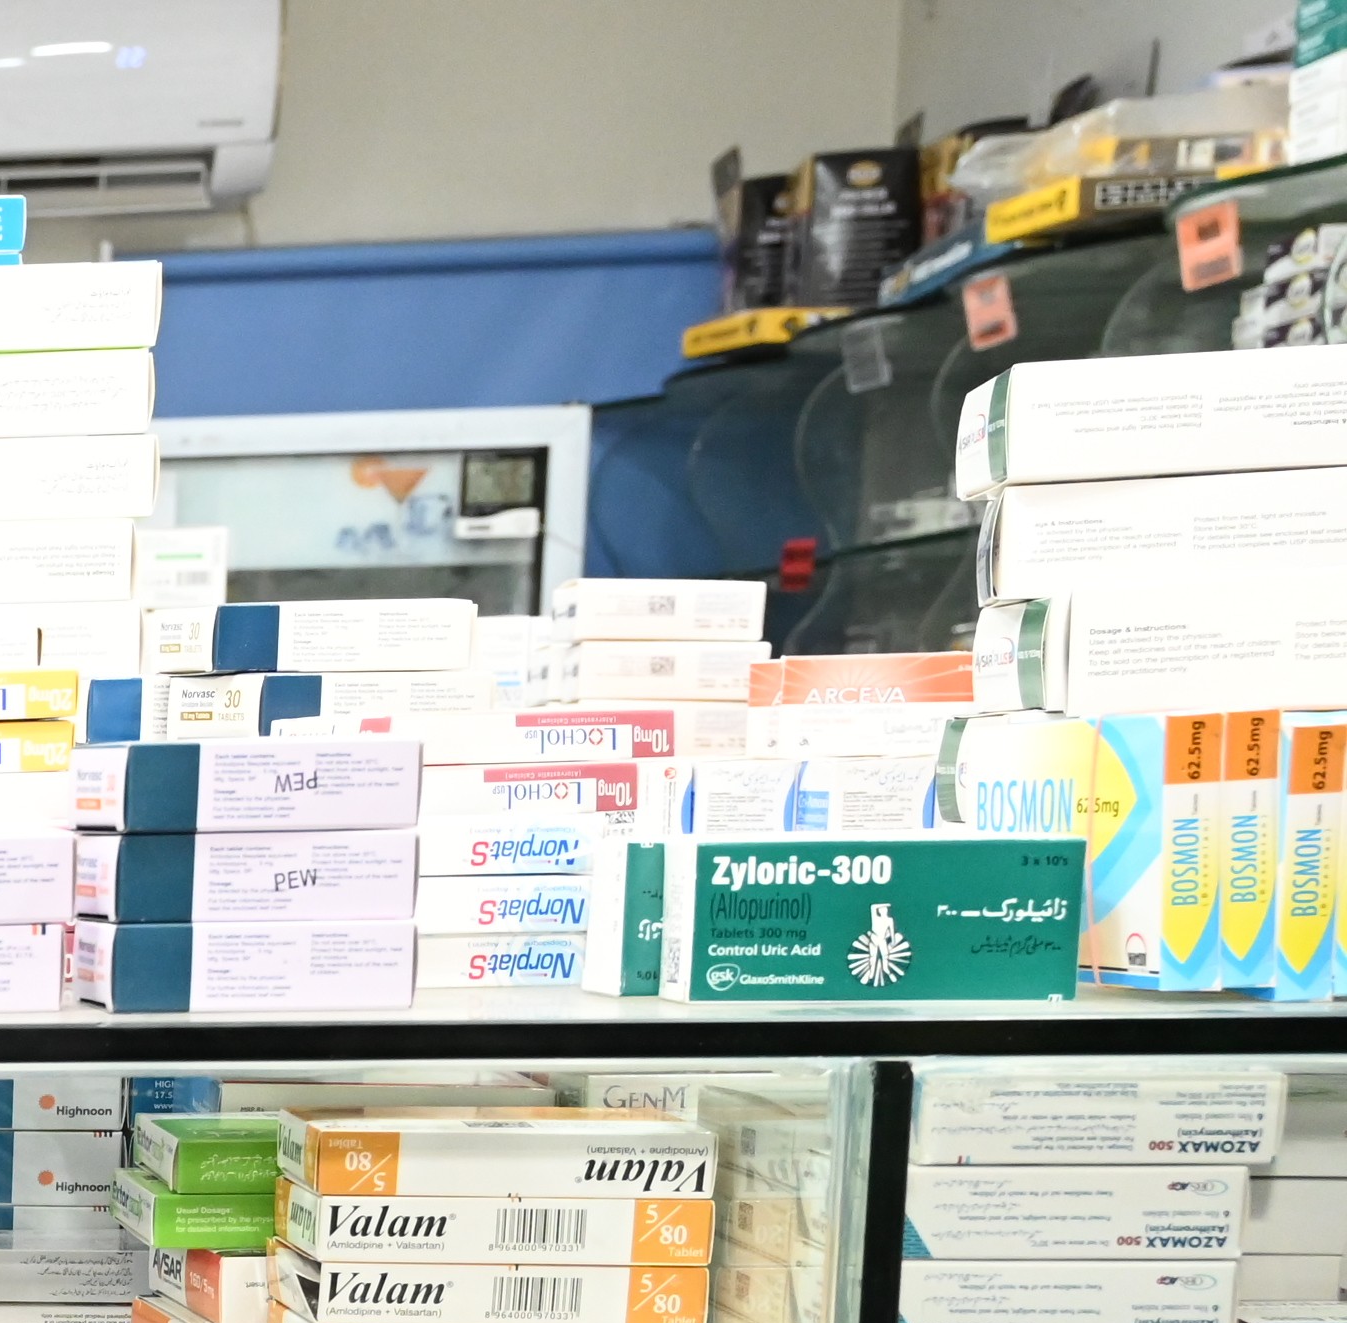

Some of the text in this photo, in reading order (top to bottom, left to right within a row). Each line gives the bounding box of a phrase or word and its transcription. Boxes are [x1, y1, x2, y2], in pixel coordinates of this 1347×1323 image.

[28, 685, 72, 711] 20mg
[182, 688, 241, 708] Norvasc 30
[806, 687, 906, 705] ARCEVA
[634, 727, 669, 752] 10mg
[24, 740, 68, 765] 20mg
[275, 771, 318, 794] PEW
[598, 780, 631, 806] 10mg
[977, 778, 1072, 832] BOSMON
[1171, 720, 1205, 906] BOSMON 62.5mg
[1231, 717, 1265, 903] BOSMON 62.5mg
[1291, 730, 1332, 917] BOSMON 62.5mg
[712, 855, 891, 891] Zyloric-300
[1021, 856, 1029, 866] 3
[1045, 856, 1068, 865] 10's
[274, 869, 318, 893] PEW
[709, 892, 811, 924] (Allopurinol)
[710, 928, 806, 942] Tablets 300 mg
[708, 943, 821, 956] Control Uric Acid
[710, 968, 736, 984] gsk
[740, 974, 824, 985] GlaxoSmithKline
[56, 1105, 112, 1117] Highnoon
[329, 1138, 362, 1148] Tablet
[1149, 1141, 1260, 1154] AZOMAX 500
[55, 1181, 110, 1193] Highnoon
[583, 1159, 705, 1192] Valam
[328, 1206, 449, 1238] Valam
[669, 1247, 703, 1257] Tablet
[1117, 1236, 1227, 1248] AZOMAX 500
[153, 1250, 182, 1282] AVSAR
[326, 1273, 446, 1306] Valam
